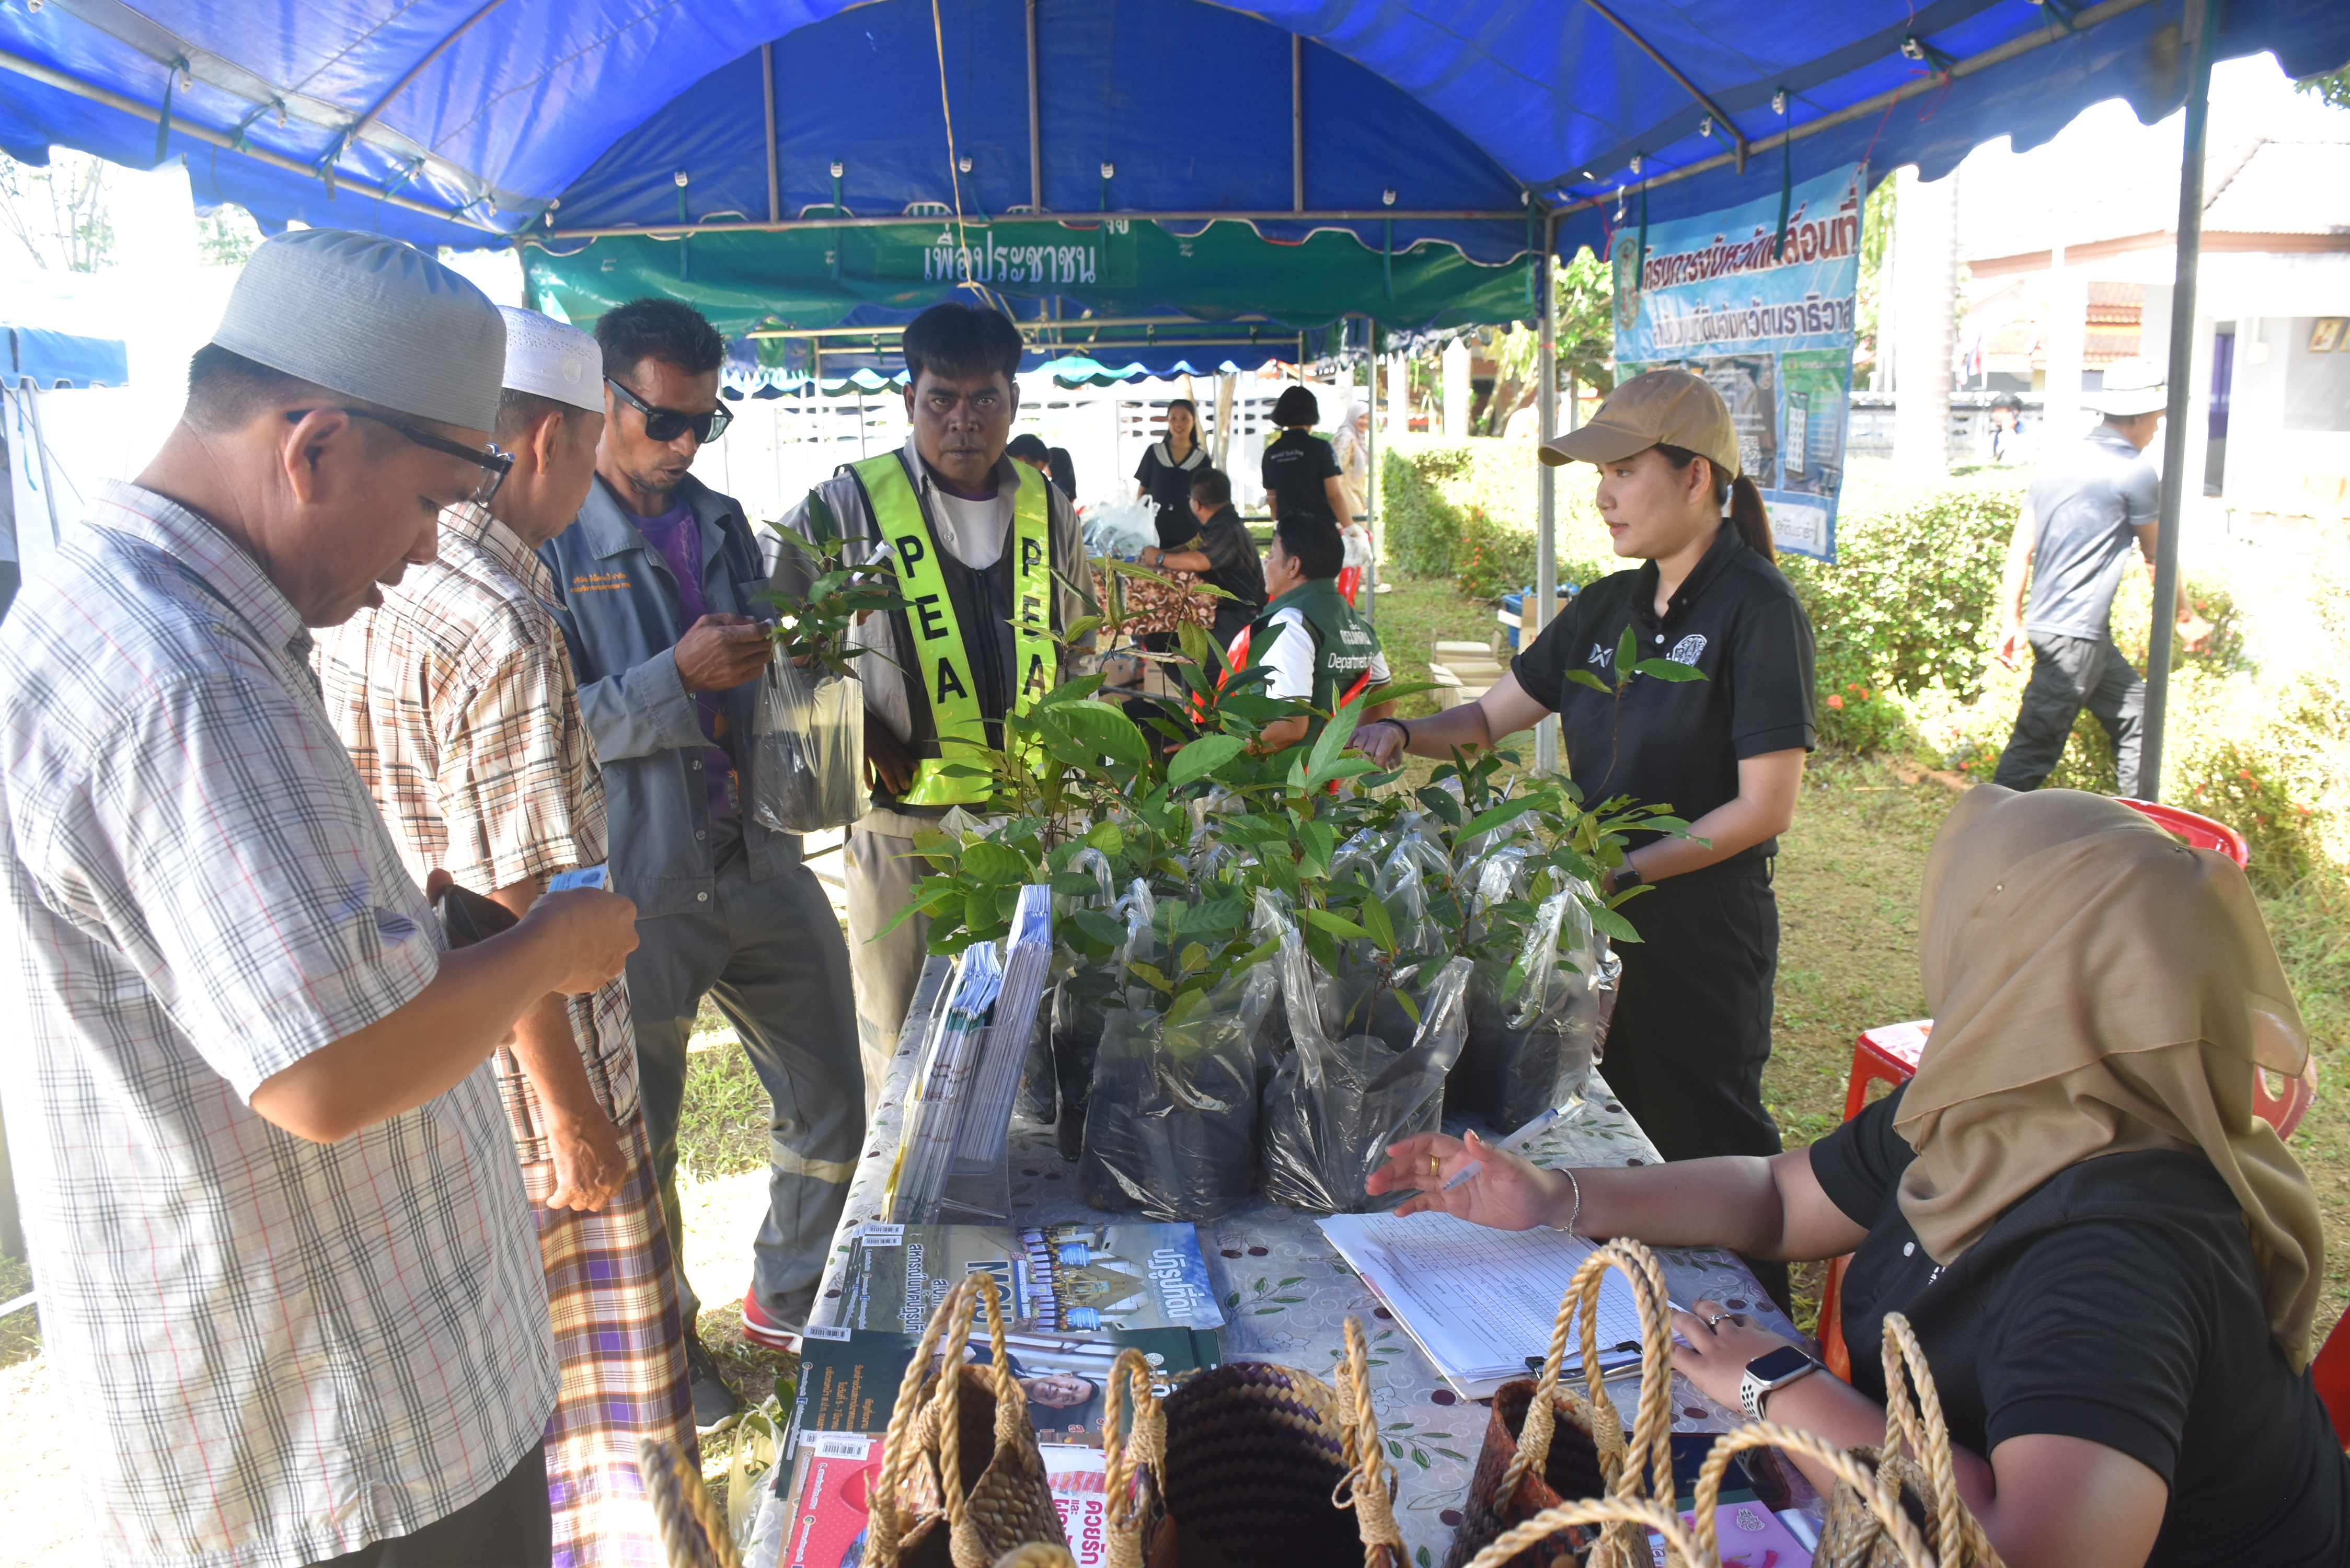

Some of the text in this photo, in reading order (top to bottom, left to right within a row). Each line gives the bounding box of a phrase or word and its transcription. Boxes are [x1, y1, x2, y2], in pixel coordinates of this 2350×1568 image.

[924, 222, 1096, 283] เพื่อประชาชน
[895, 534, 969, 705] PEA
[1021, 536, 1046, 699] PEA
[898, 1244, 928, 1334] สหกรณ์ในเขตปฏิรูปที
[967, 1261, 1012, 1323] MOU
[1146, 1248, 1206, 1319] ปฏิรูปที่ดิน
[1070, 1500, 1080, 1515] และ
[1080, 1500, 1106, 1565] ดวยรัก
